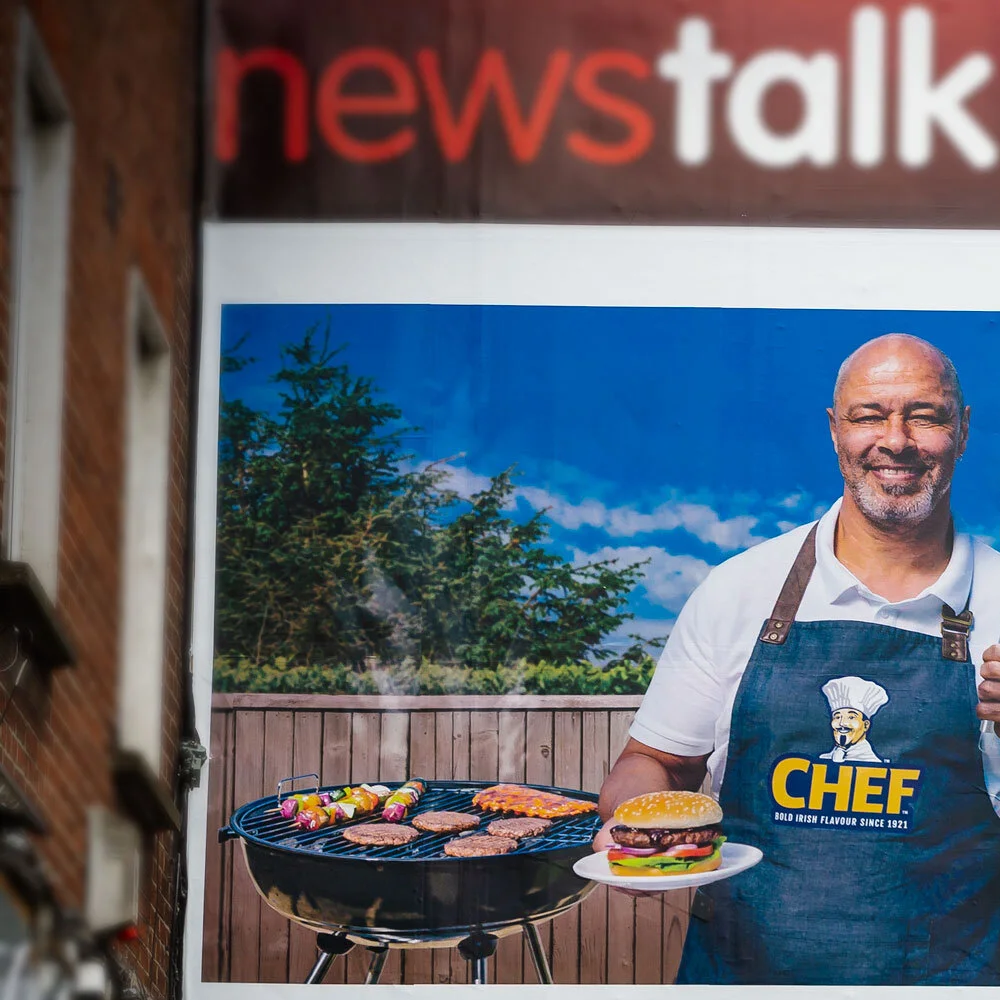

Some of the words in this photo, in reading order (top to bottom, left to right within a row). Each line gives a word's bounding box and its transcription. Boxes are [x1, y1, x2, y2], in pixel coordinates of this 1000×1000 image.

[771, 757, 921, 815] CHEF
[774, 811, 793, 822] BOLD
[795, 813, 818, 824] IRISH
[820, 815, 857, 826] FLAVOUR
[859, 818, 884, 828] SINCE
[887, 819, 908, 829] 1921
